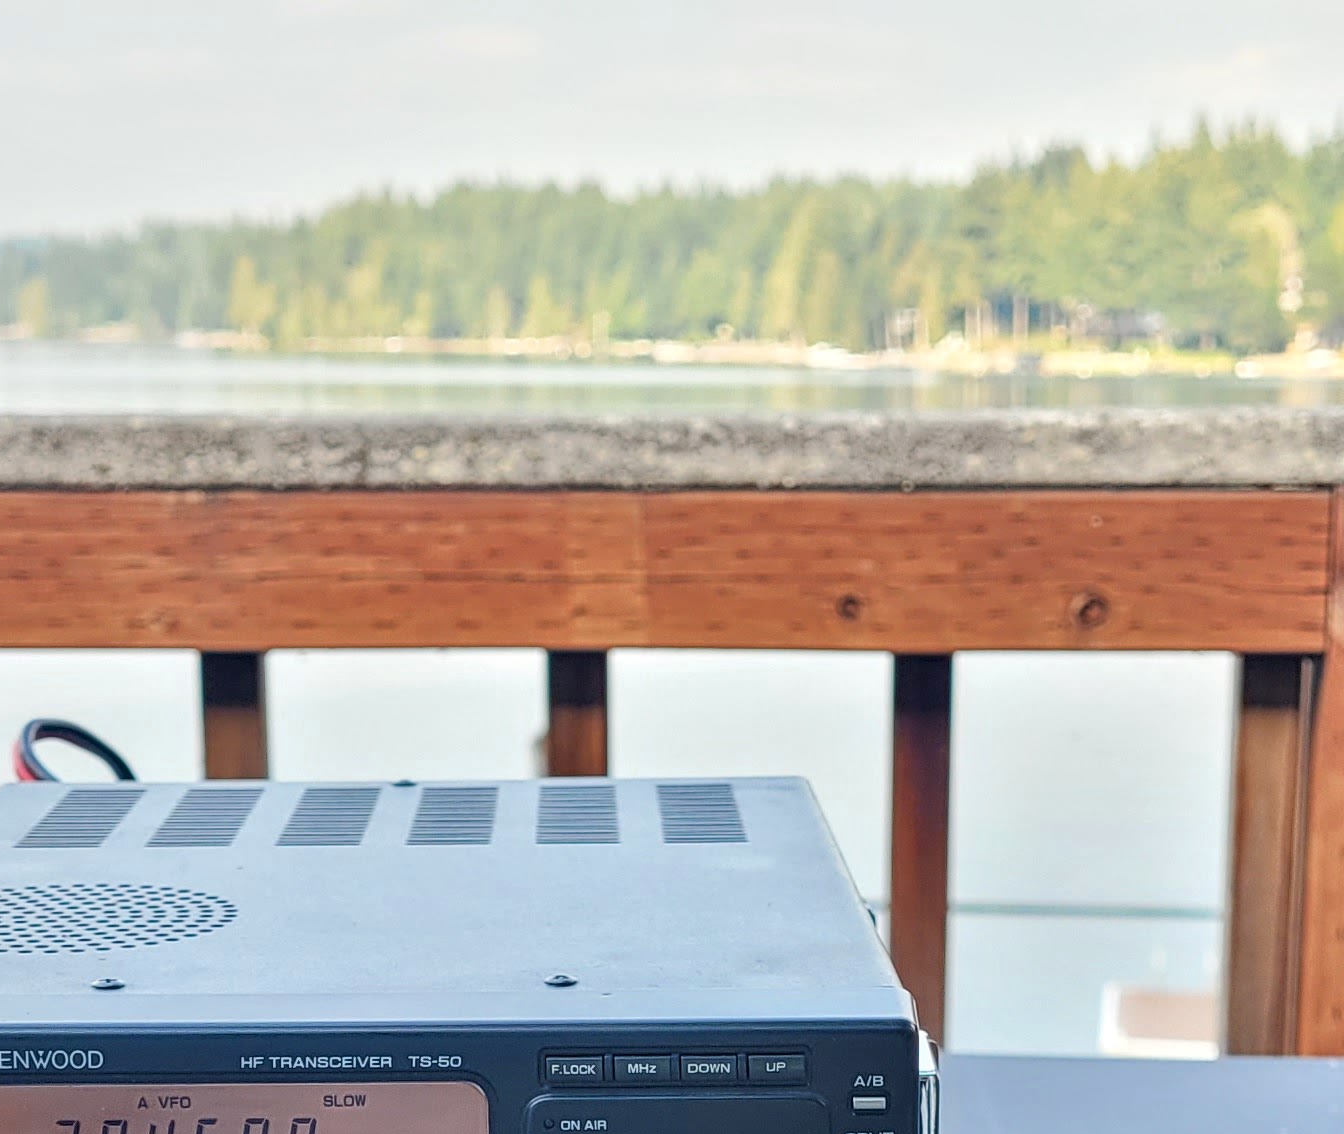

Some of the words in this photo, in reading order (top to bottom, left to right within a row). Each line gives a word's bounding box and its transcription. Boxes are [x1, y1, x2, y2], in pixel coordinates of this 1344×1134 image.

[240, 1056, 265, 1069] HF
[268, 1055, 393, 1069] TRANSCEIVER
[407, 1055, 463, 1069] TS-50
[626, 1062, 657, 1075] MHz
[686, 1062, 732, 1075] DOWN
[765, 1061, 787, 1073] UP
[550, 1063, 597, 1076] F.LOCK
[853, 1074, 885, 1088] A/B
[137, 1096, 149, 1109] A
[158, 1096, 192, 1109] VFO
[322, 1094, 367, 1108] SLOW
[560, 1119, 581, 1132] ON
[583, 1119, 608, 1132] AIR
